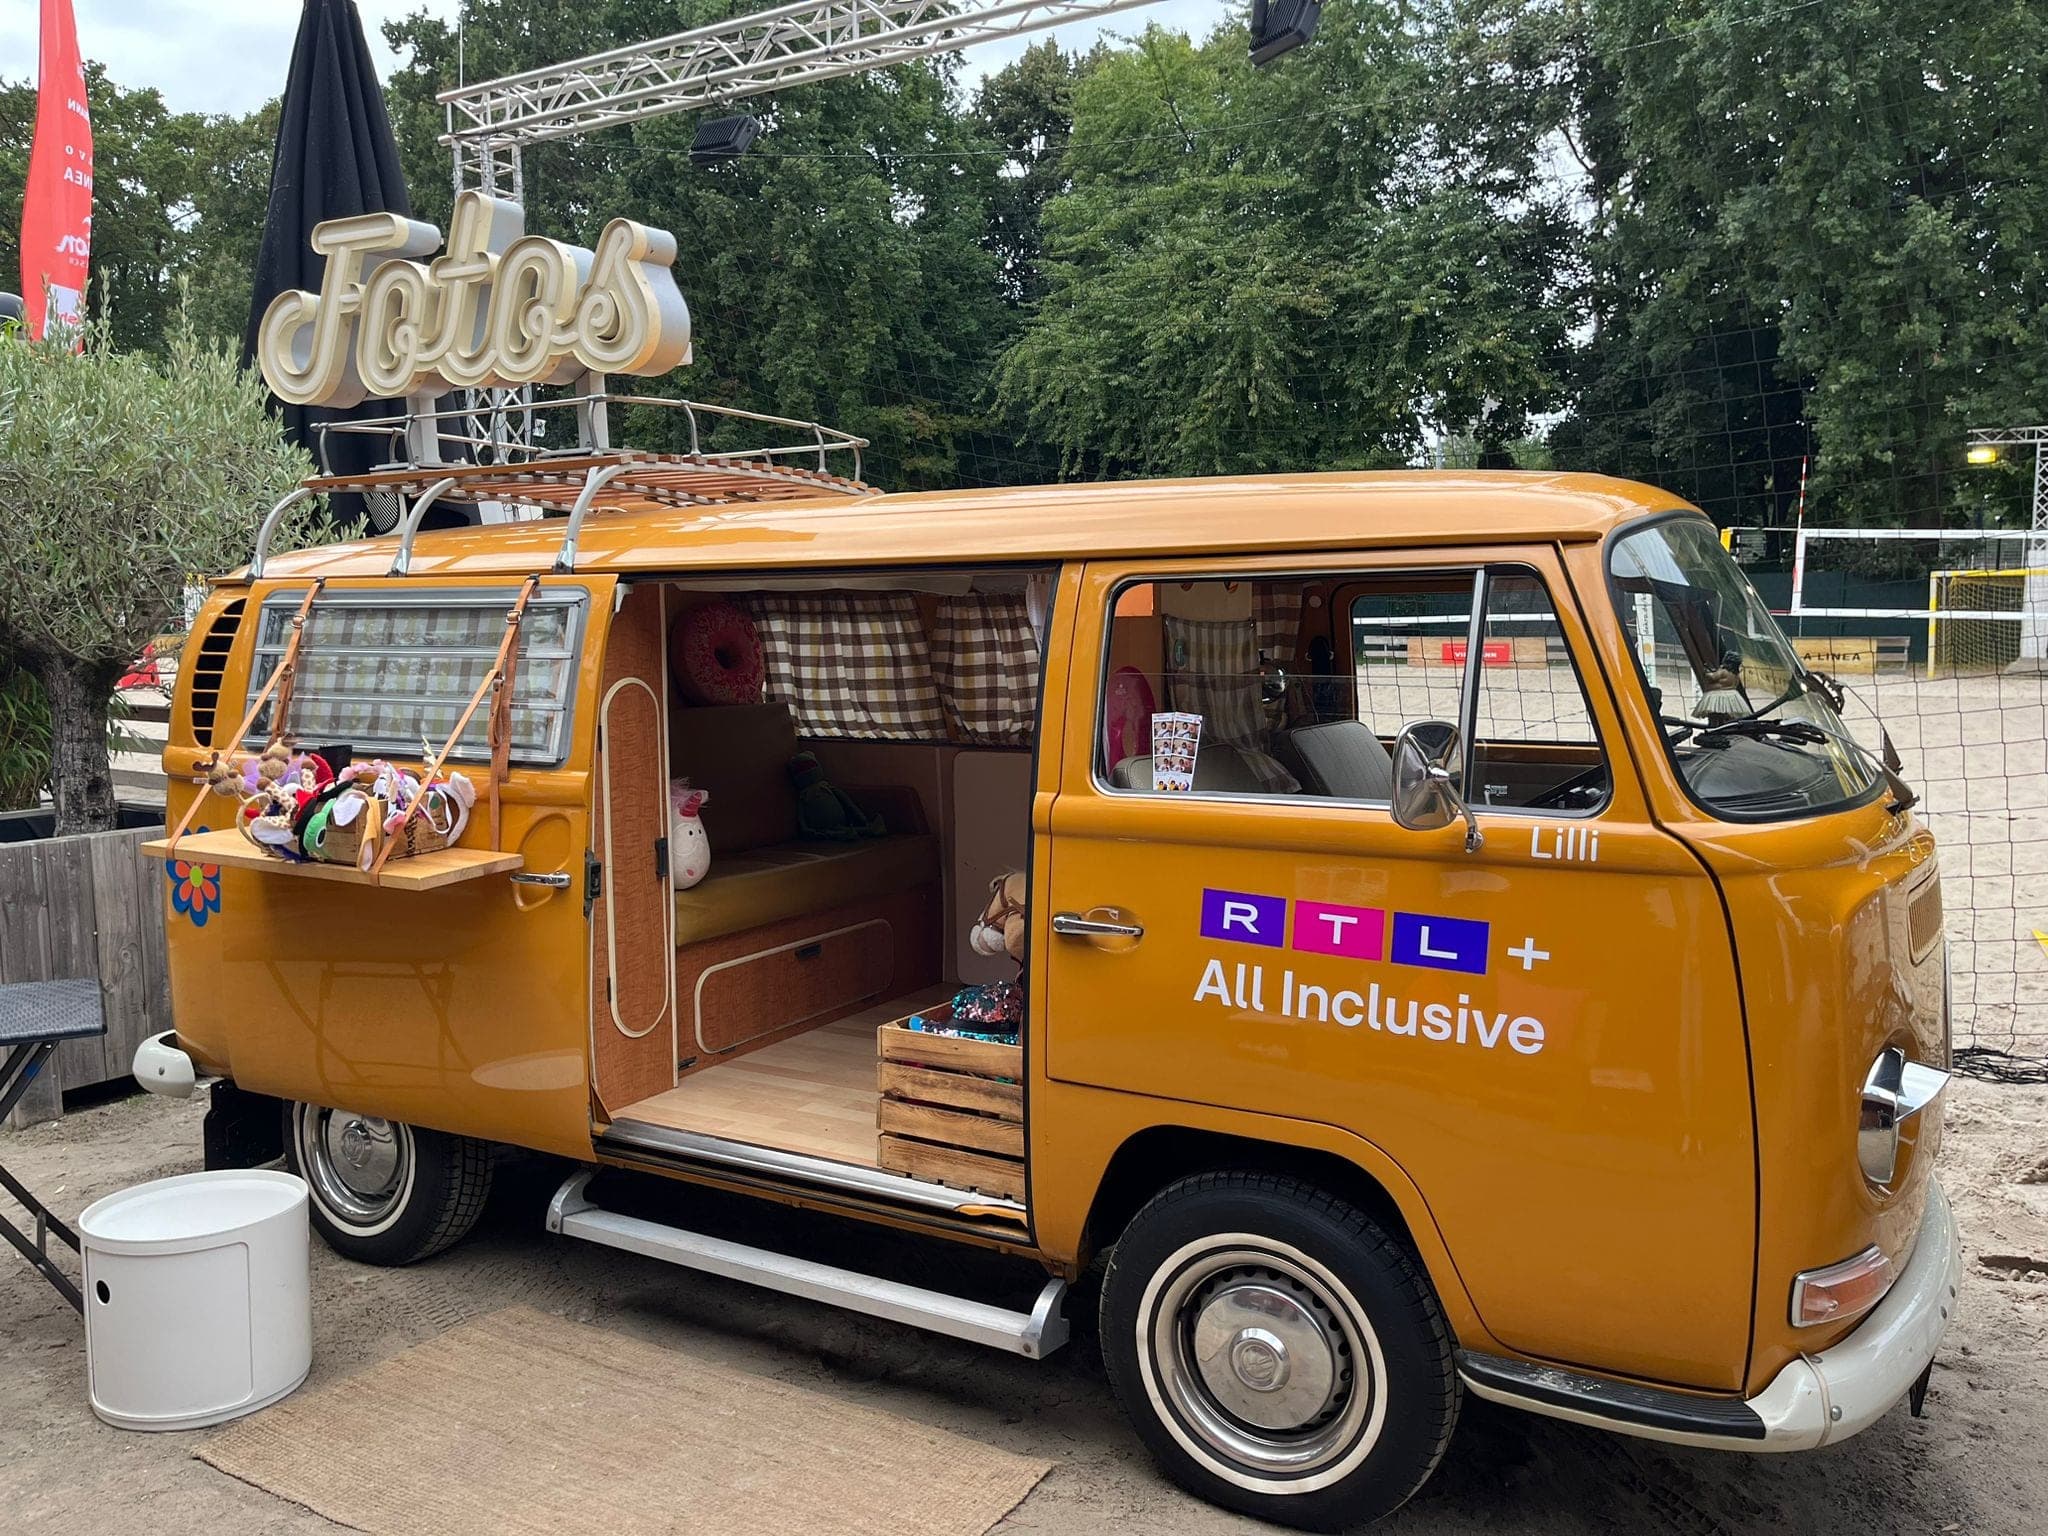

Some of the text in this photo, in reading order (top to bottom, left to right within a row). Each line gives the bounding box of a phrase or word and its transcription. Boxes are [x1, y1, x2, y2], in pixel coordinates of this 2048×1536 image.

[258, 190, 688, 408] Fotos
[1817, 652, 1861, 661] LINEA
[1531, 826, 1598, 862] Lilli
[1194, 959, 1545, 1054] All Inclusive
